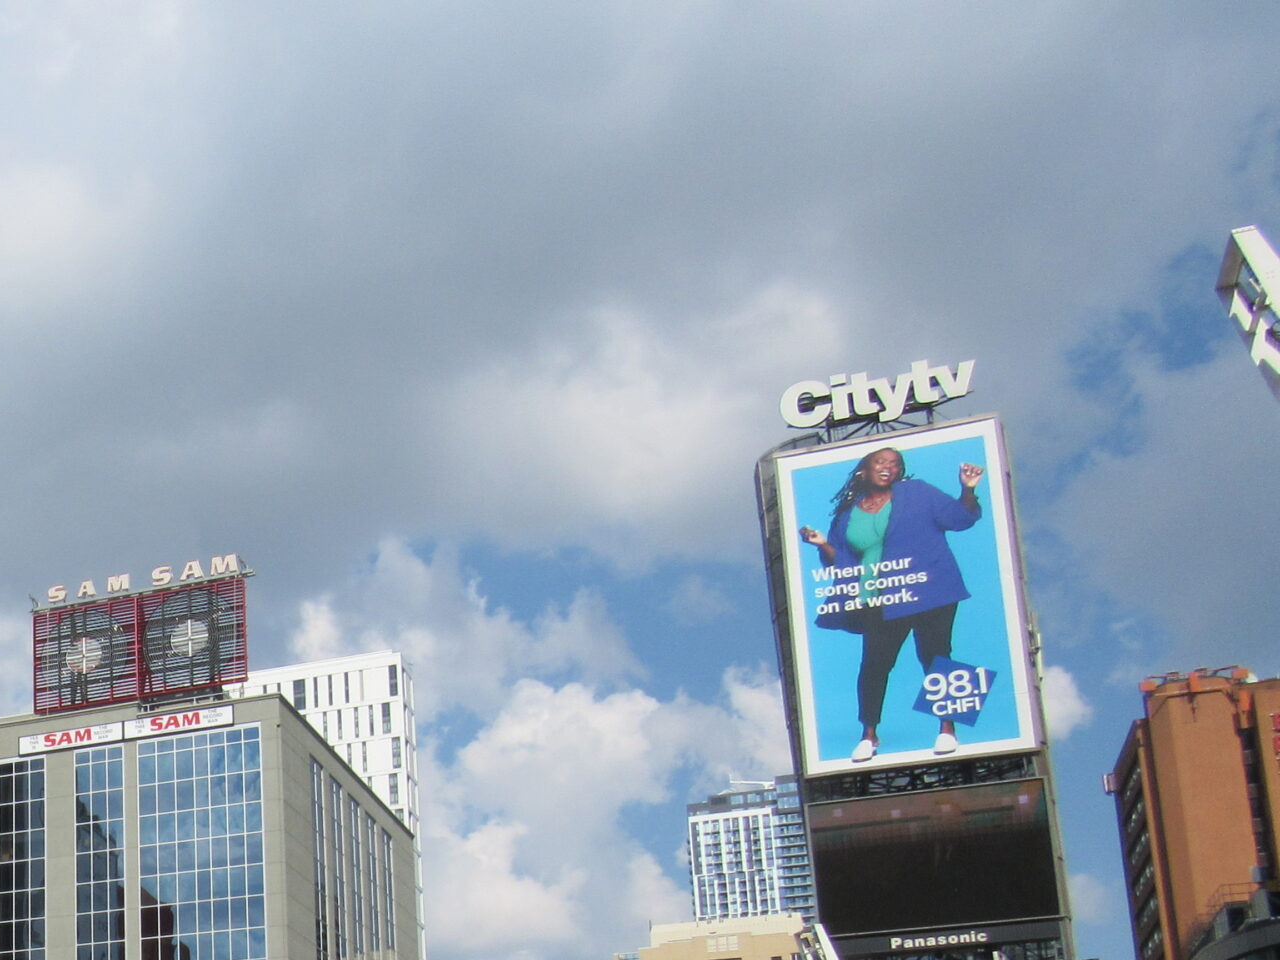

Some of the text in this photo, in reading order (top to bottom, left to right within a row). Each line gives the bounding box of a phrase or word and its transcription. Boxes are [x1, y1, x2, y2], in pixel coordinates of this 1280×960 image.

[780, 359, 976, 428] Citytv
[47, 553, 239, 603] SAM SAM
[811, 557, 912, 582] When your
[814, 571, 928, 598] song comes
[816, 588, 919, 615] on at work.
[923, 667, 988, 701] 98.1
[932, 697, 981, 716] CHFI
[150, 712, 201, 732] SAM
[44, 727, 93, 748] SAM
[890, 930, 988, 949] Panasonic
